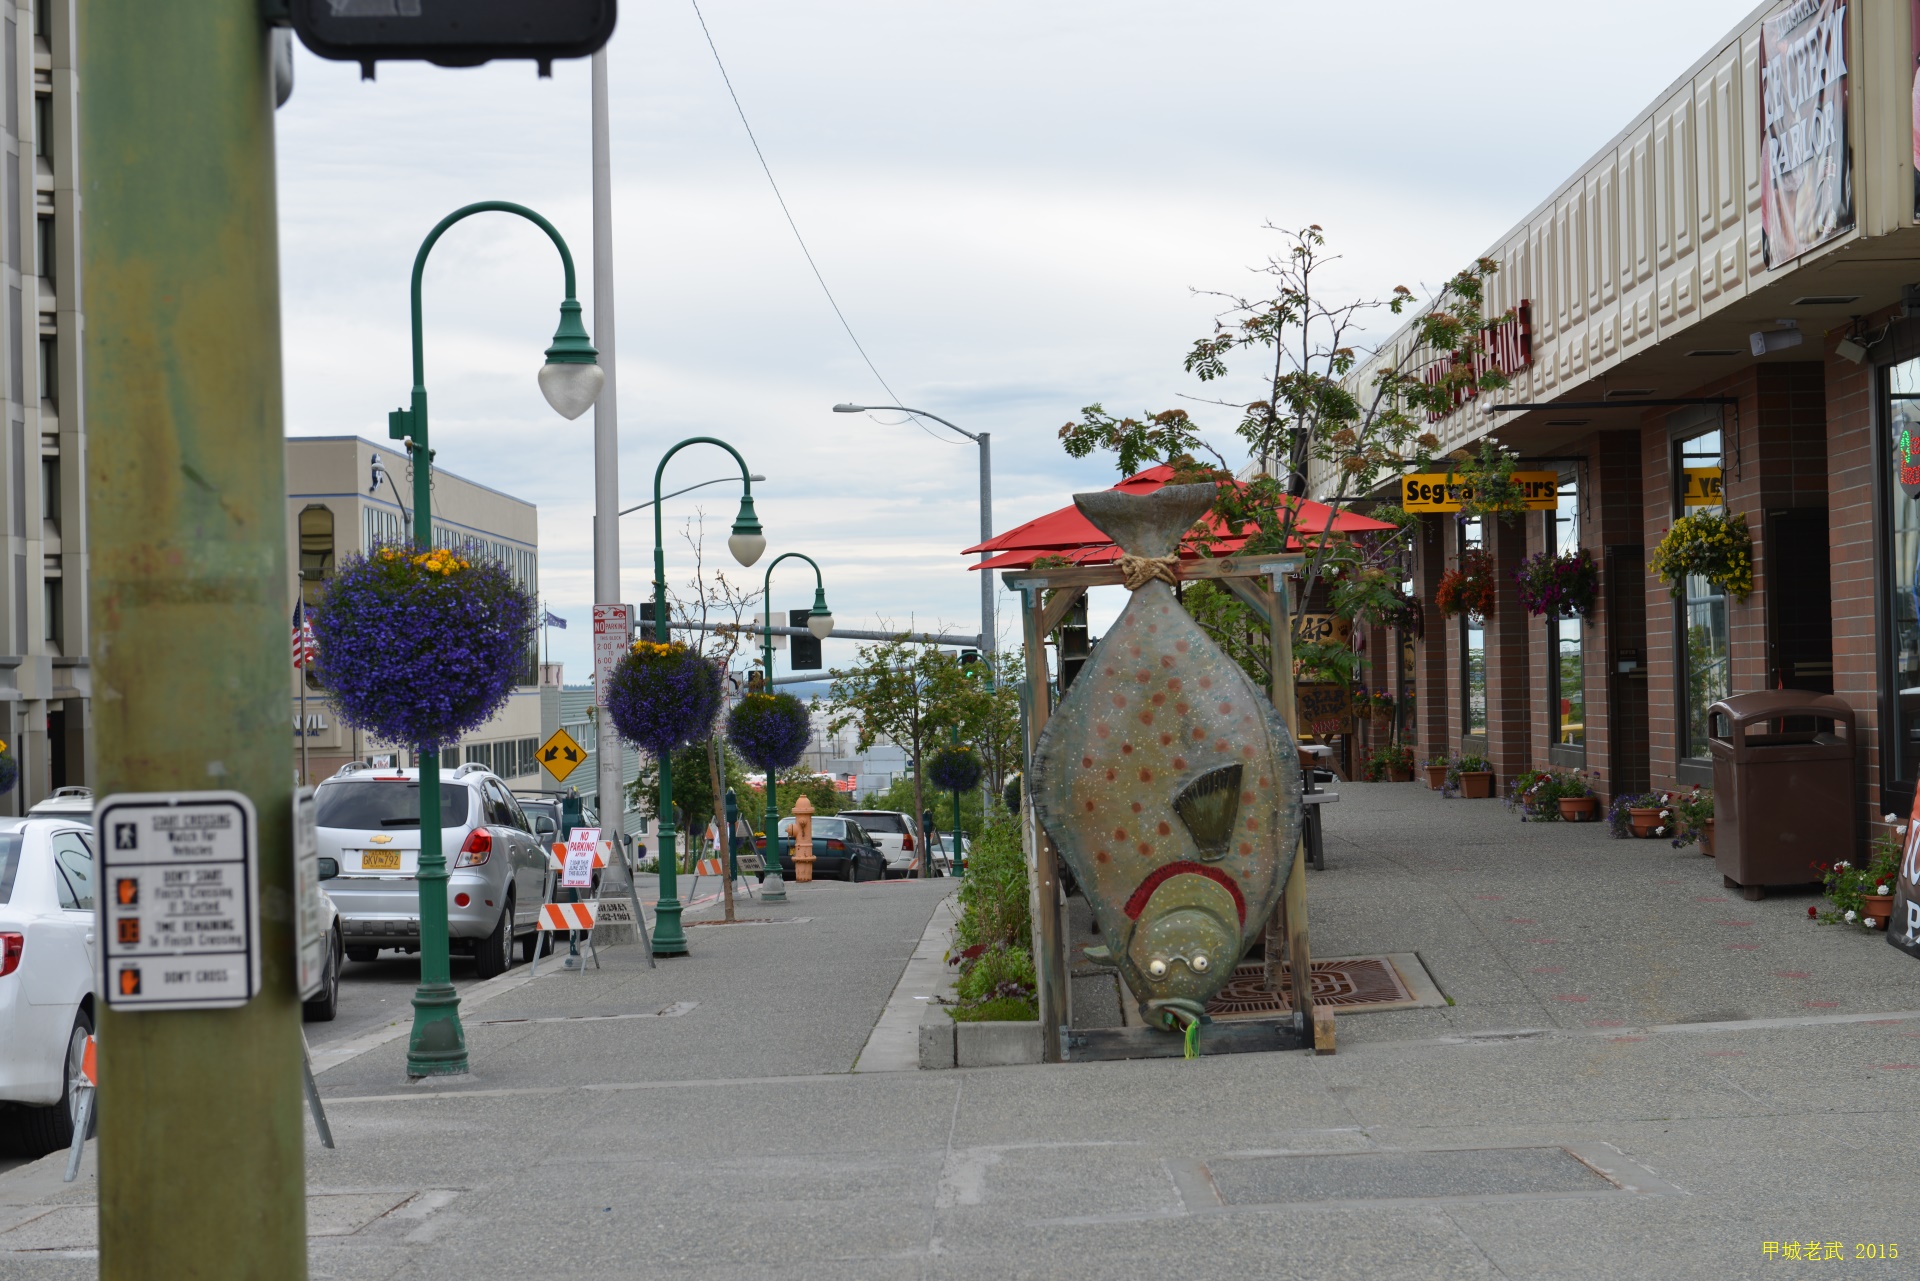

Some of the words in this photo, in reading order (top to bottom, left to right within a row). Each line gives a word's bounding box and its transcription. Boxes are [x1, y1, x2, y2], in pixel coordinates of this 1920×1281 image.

[1786, 5, 1848, 113] CREAM
[1769, 101, 1836, 180] PARLOR
[594, 621, 605, 633] NO
[605, 623, 626, 631] PARKING
[152, 815, 179, 826] START
[183, 812, 231, 826] CROSSING
[580, 831, 590, 841] NO
[570, 841, 595, 852] PARKING
[384, 856, 399, 866] 792
[196, 969, 228, 982] CROSS
